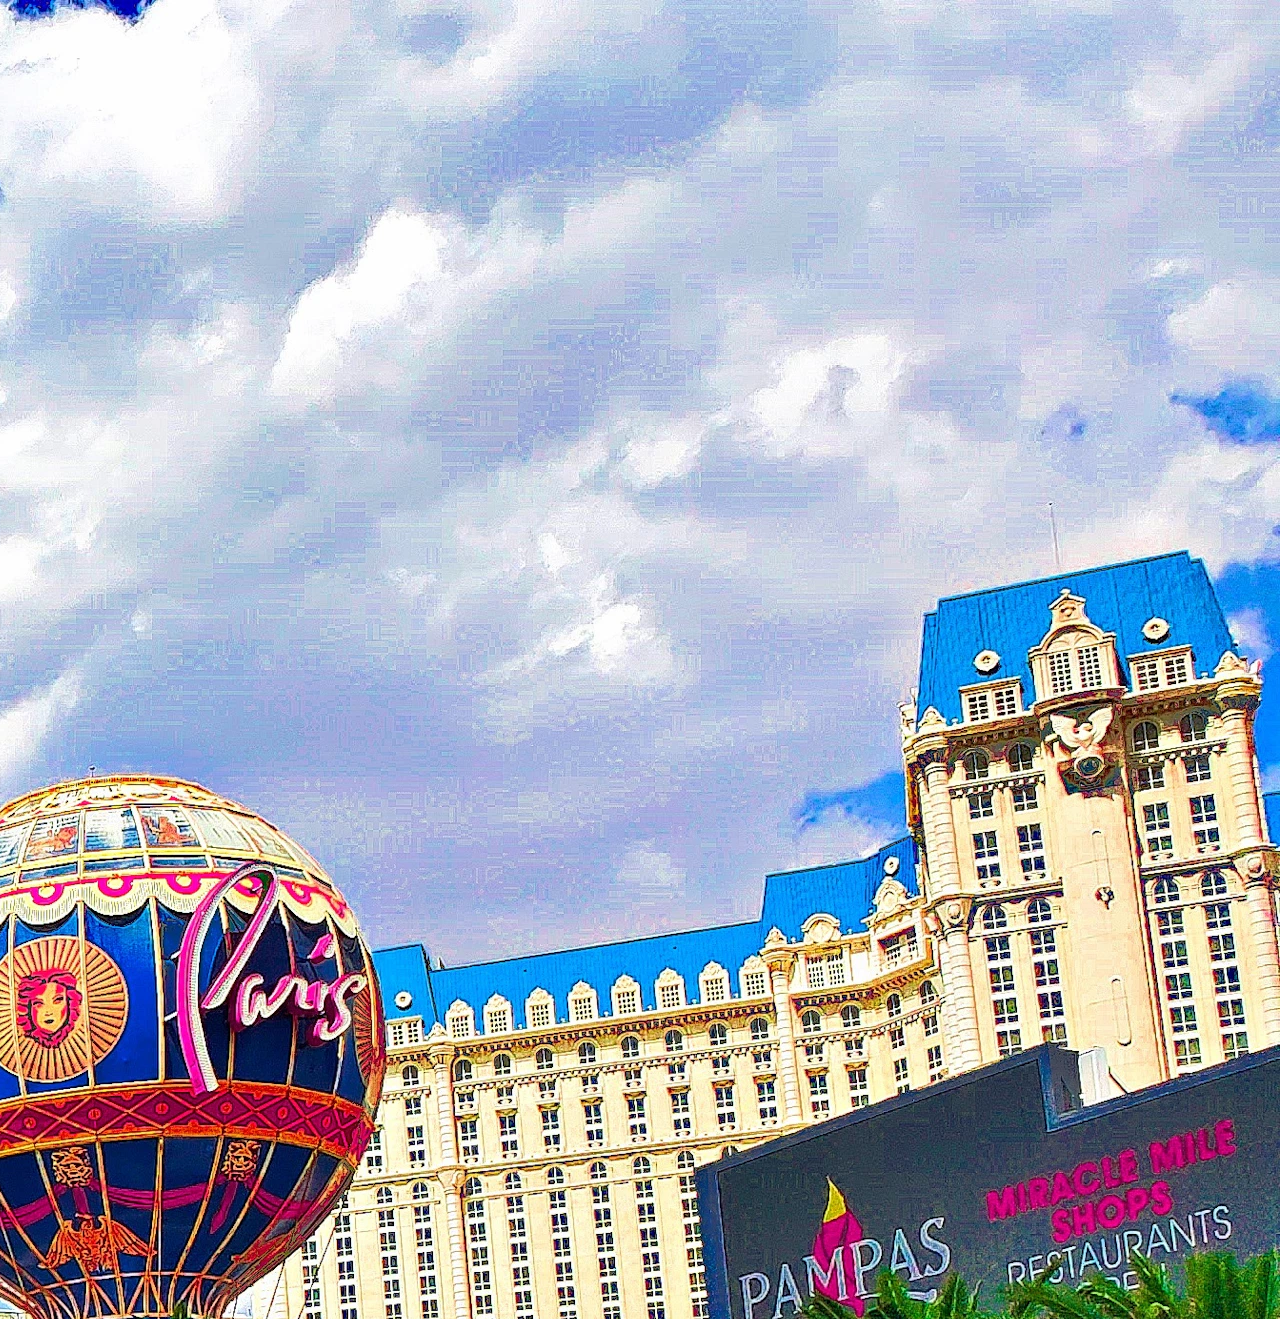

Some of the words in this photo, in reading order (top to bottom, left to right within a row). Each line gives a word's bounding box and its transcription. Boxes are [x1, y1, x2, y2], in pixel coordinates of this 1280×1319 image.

[176, 861, 365, 1094] Paris
[986, 1150, 1138, 1221] MIRACLE
[1149, 1119, 1236, 1174] MILE
[1051, 1180, 1172, 1243] SHOPS
[1007, 1205, 1232, 1284] RESTAURANTS
